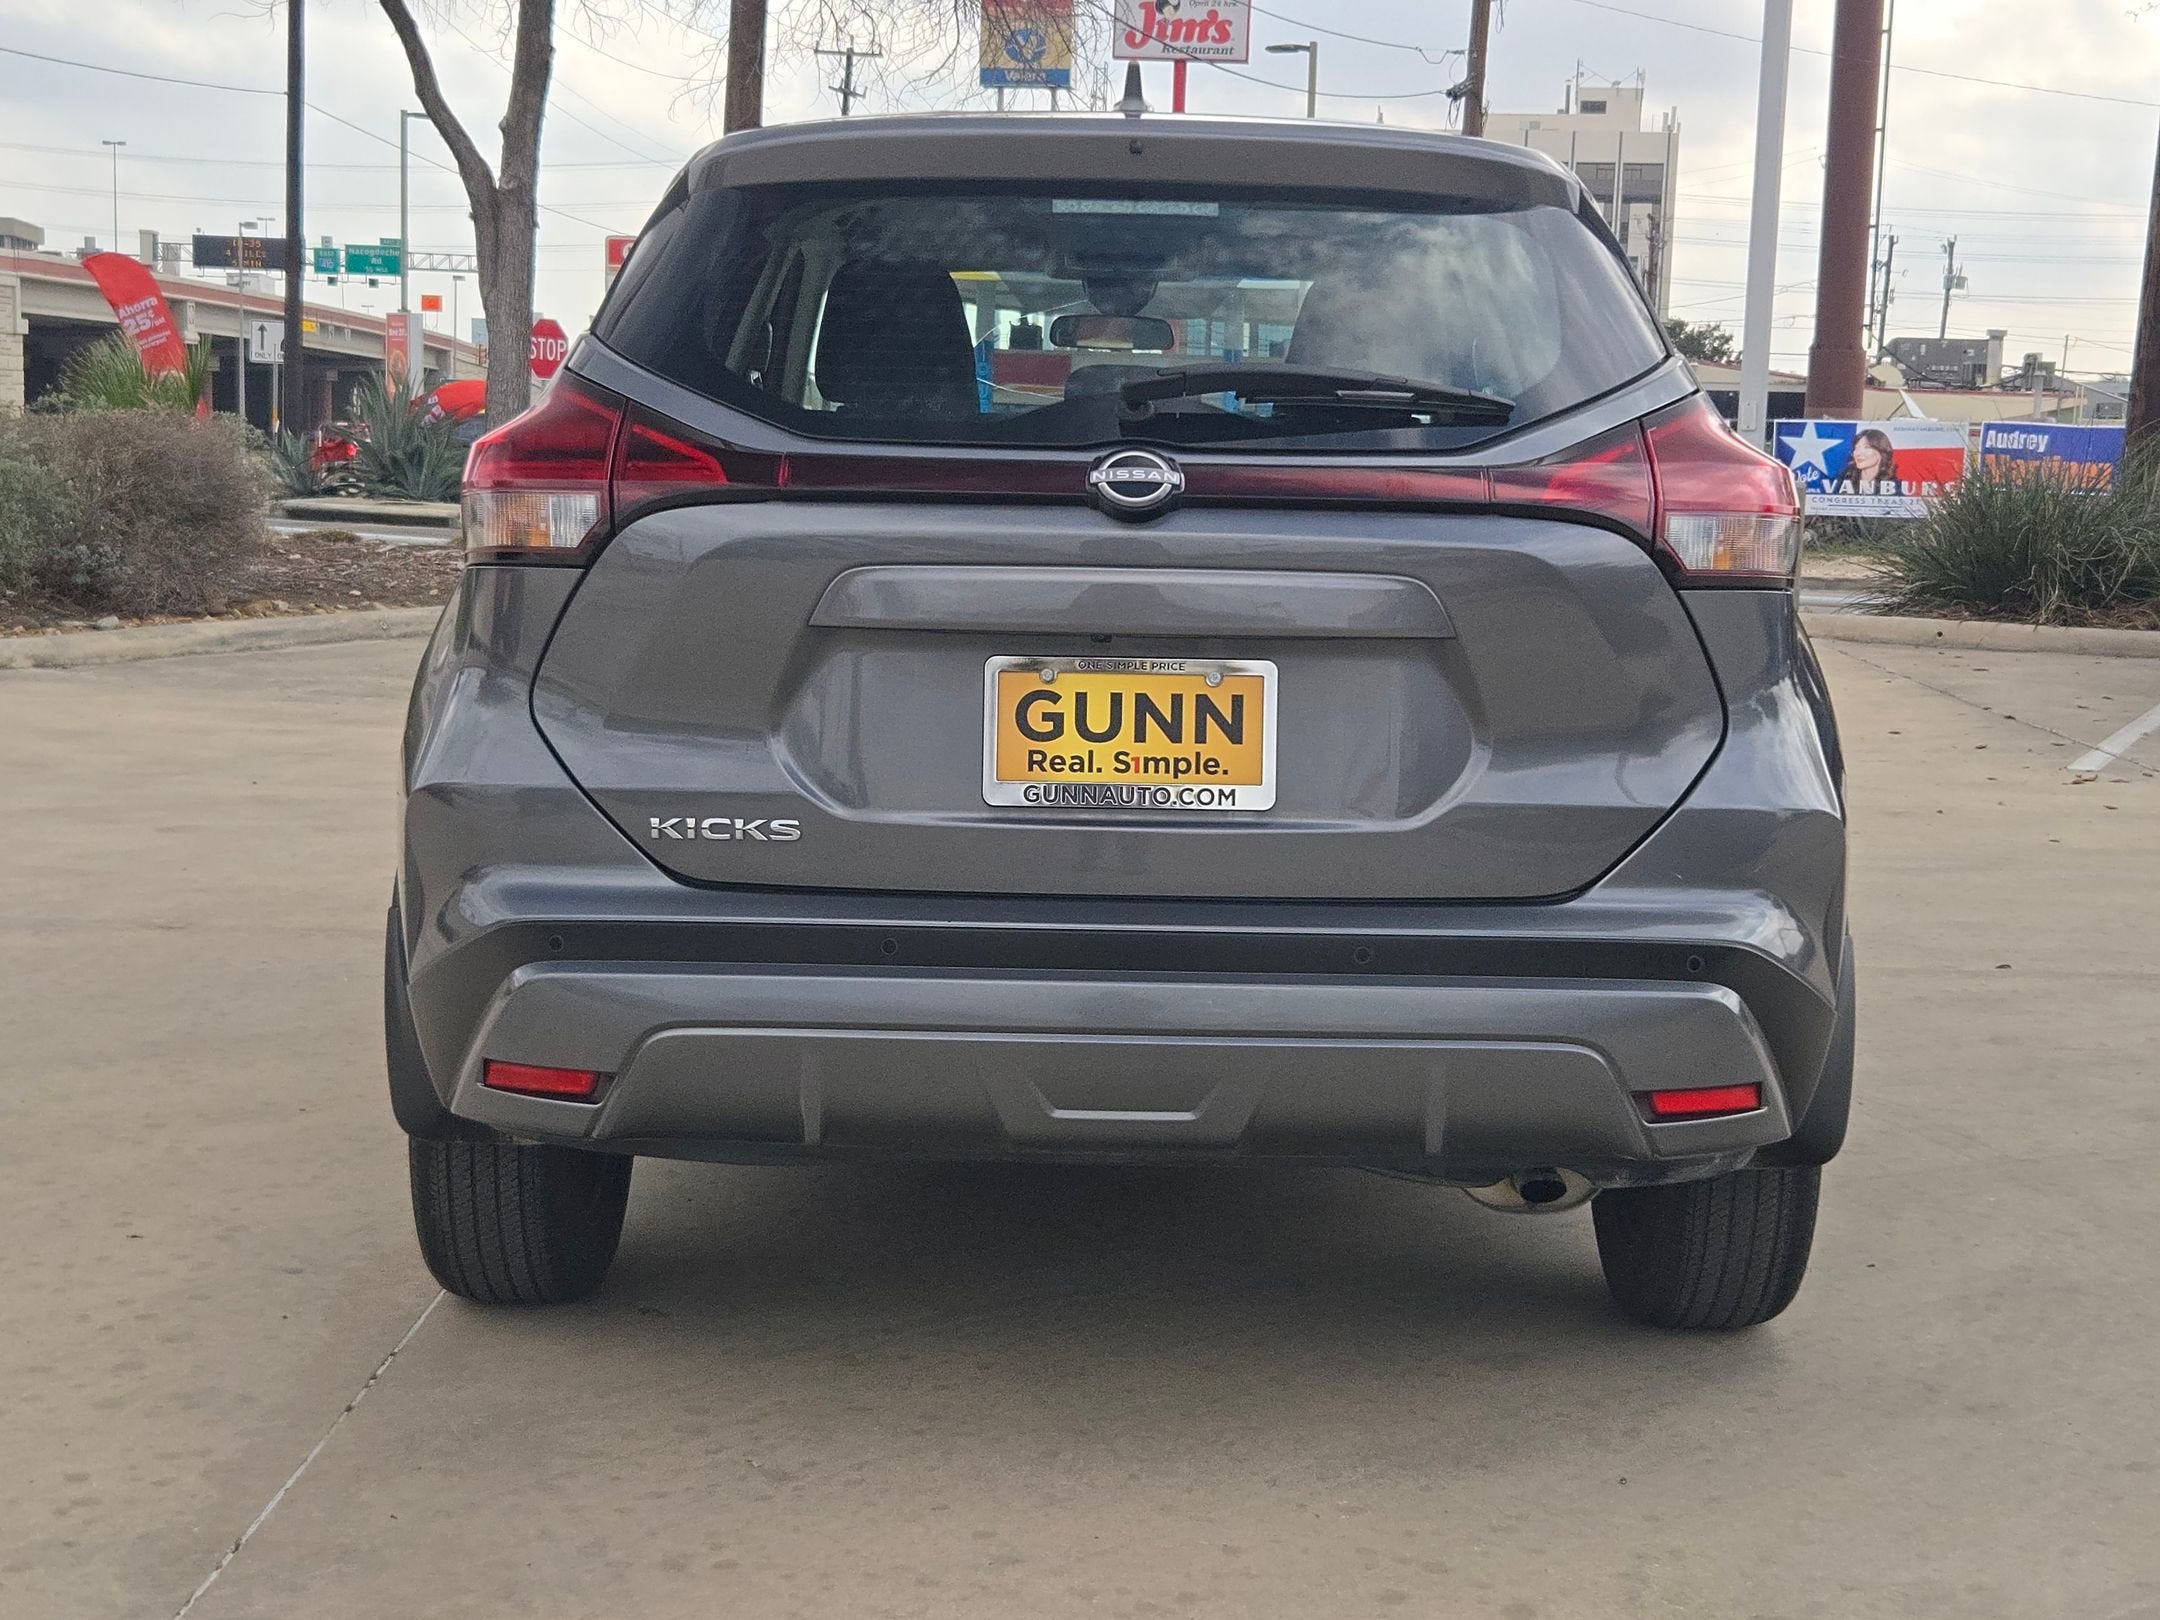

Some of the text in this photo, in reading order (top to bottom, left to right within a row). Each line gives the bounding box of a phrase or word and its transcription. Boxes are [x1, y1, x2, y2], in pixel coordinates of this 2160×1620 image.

[1124, 1, 1232, 49] Jim's
[1160, 45, 1235, 55] Restaurant
[348, 248, 400, 257] Nacogdoche
[119, 296, 158, 319] Ahorra
[530, 337, 567, 361] STOP
[1985, 430, 2049, 453] Audrey
[1092, 470, 1178, 482] NISSAN
[1812, 496, 1866, 505] CONGRESS
[1077, 660, 1186, 672] ONE SIMPLE PRICE
[1015, 689, 1244, 745] GUNN
[1027, 750, 1103, 773] Real.
[1023, 785, 1236, 807] GUNNAUTO.COM
[650, 817, 801, 841] KICKS
